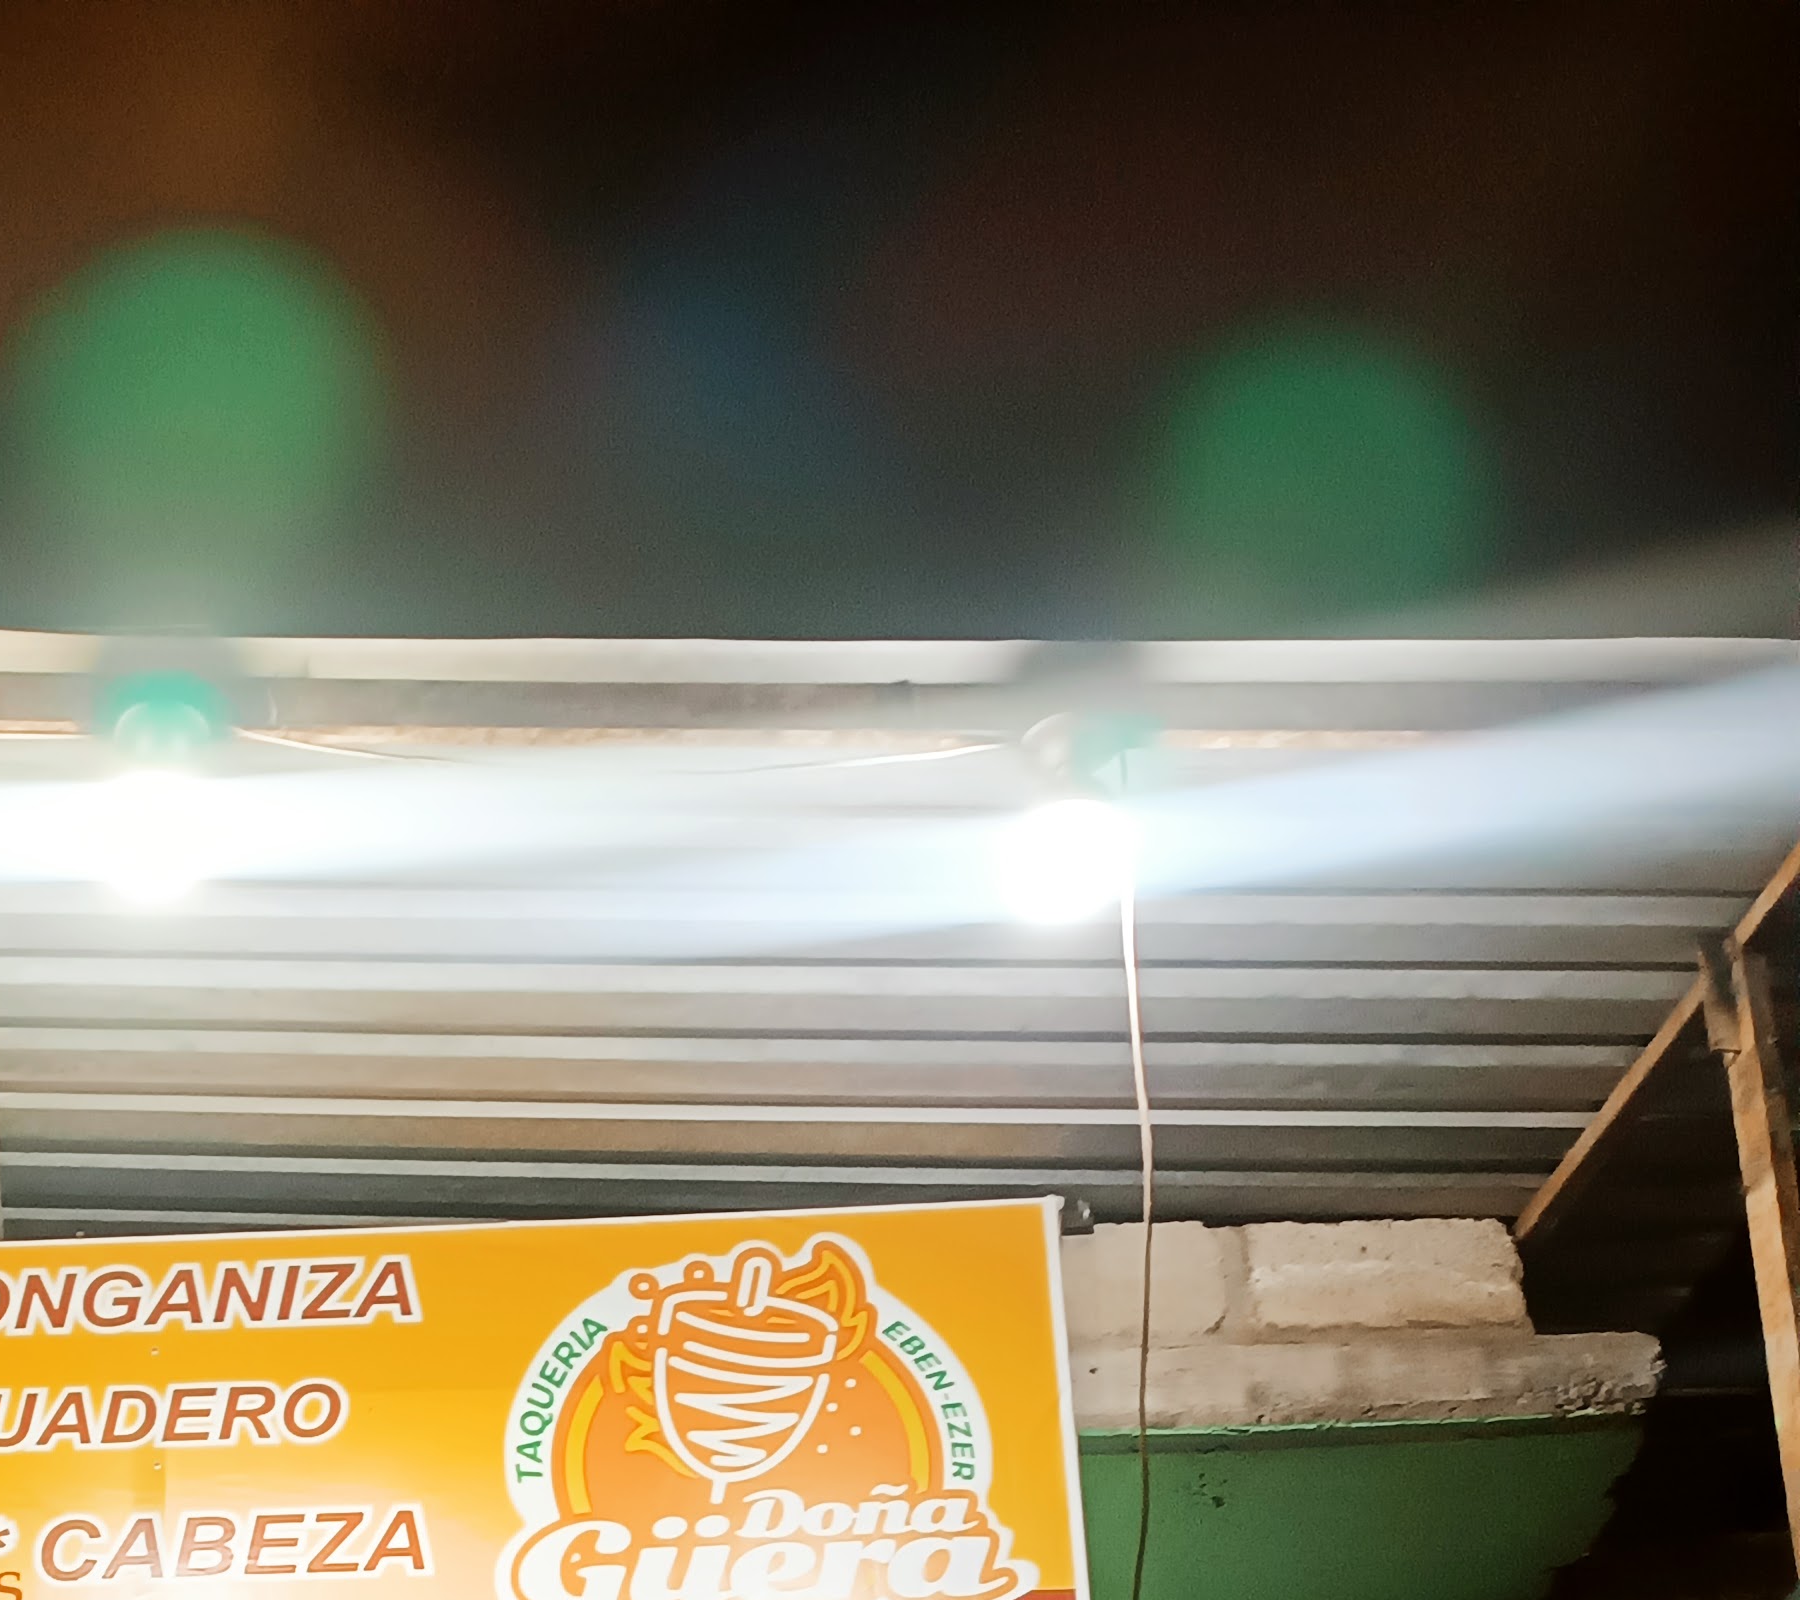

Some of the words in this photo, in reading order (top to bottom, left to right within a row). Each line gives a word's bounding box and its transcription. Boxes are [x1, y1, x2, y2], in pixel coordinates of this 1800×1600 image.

[516, 1317, 608, 1484] TAQUERIA
[881, 1319, 976, 1482] EBEN-EZER
[40, 1509, 427, 1582] CABEZA
[736, 1484, 979, 1539] Doña
